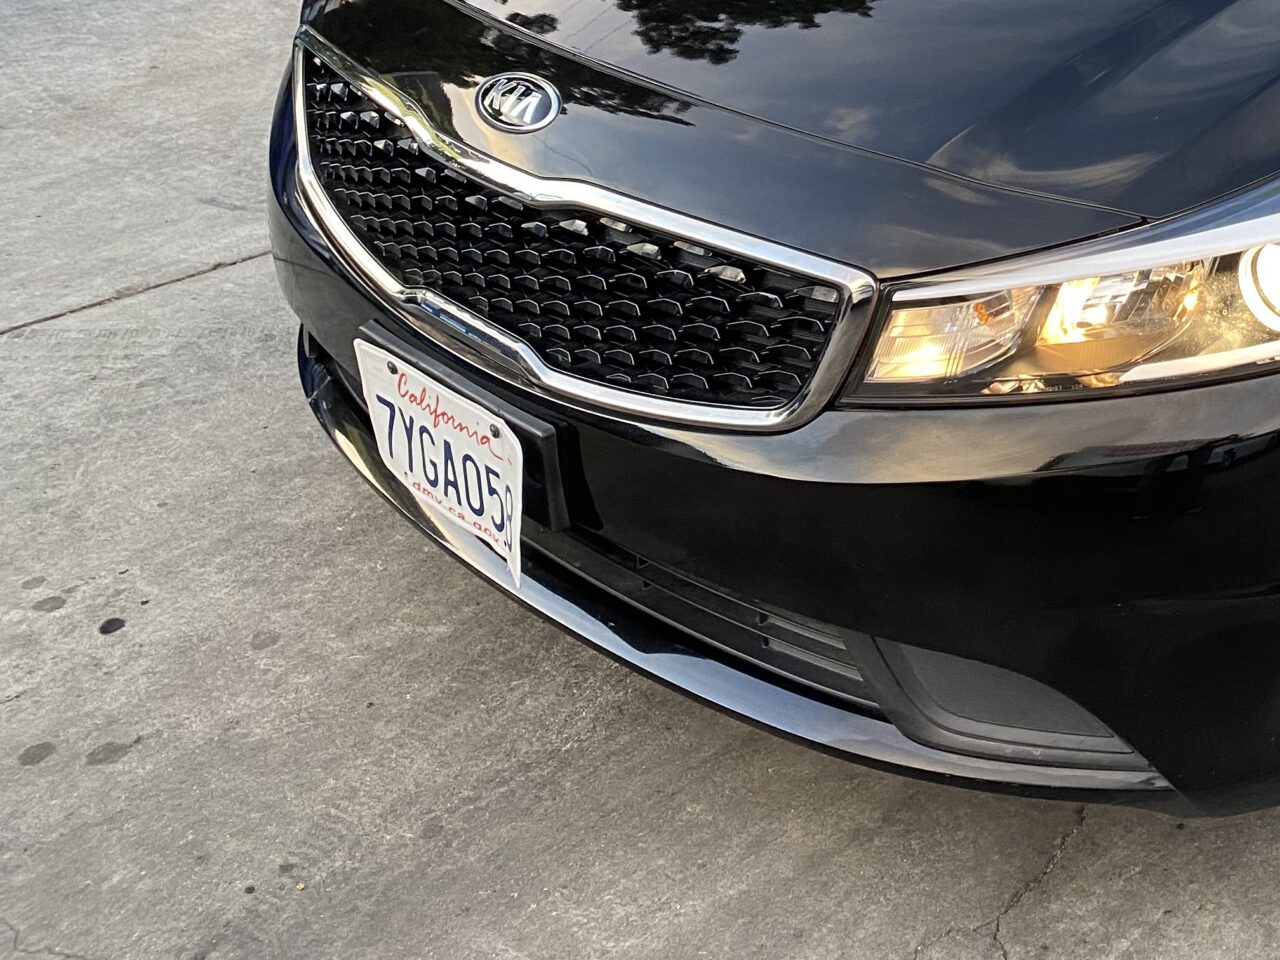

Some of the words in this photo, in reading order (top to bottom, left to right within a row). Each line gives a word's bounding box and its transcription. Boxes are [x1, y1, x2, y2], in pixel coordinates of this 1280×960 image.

[483, 78, 543, 125] KIA
[397, 372, 504, 460] California
[376, 393, 514, 554] 7YGA058
